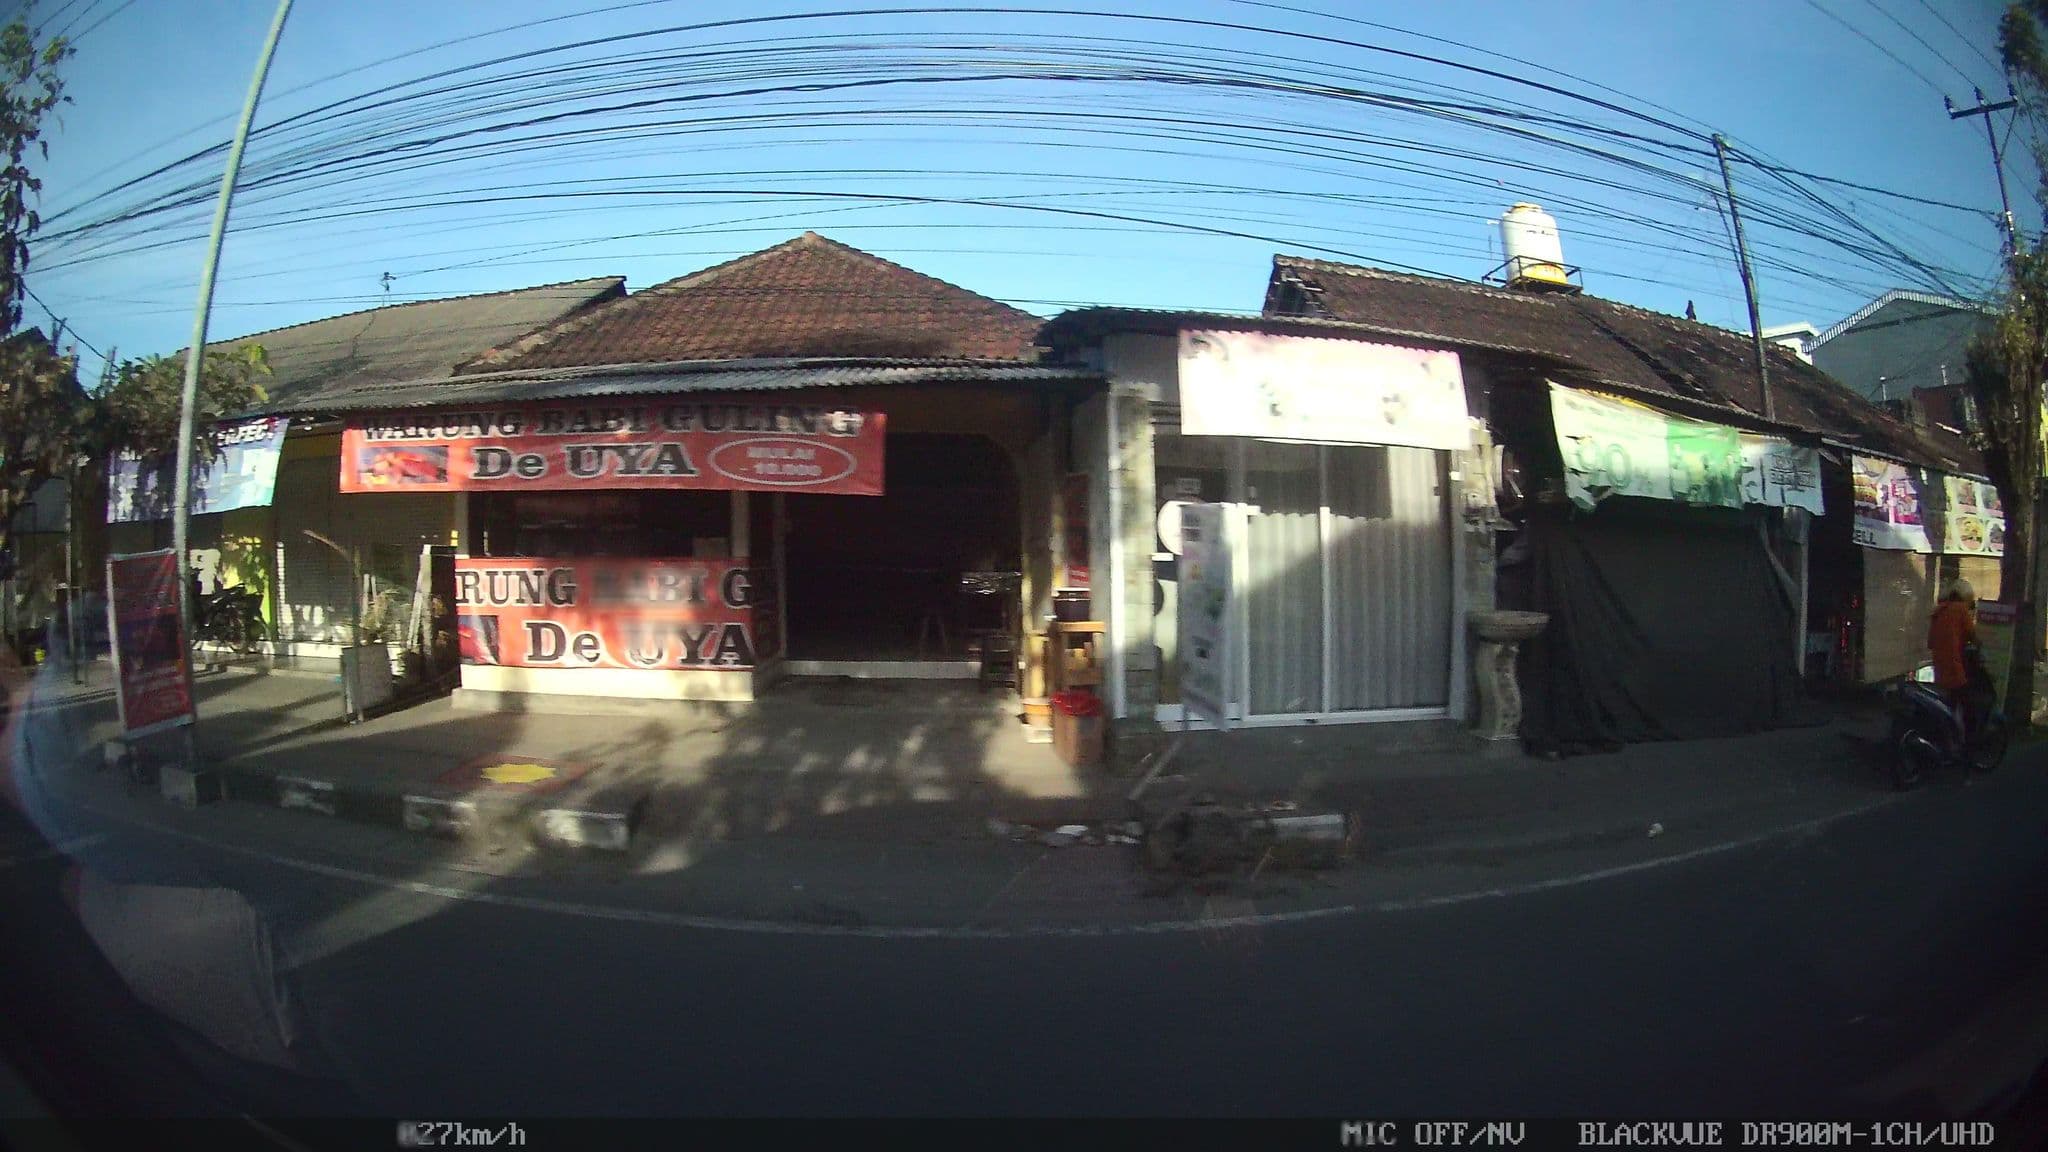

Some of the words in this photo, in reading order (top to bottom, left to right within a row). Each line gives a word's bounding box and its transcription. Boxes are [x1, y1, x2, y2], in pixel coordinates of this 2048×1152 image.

[534, 407, 651, 437] BABI
[662, 404, 863, 437] GULING
[469, 446, 547, 479] De
[562, 441, 700, 479] UYA
[454, 567, 578, 608] RUNG
[721, 566, 753, 609] G
[525, 620, 602, 666] De
[625, 620, 755, 667] UYA
